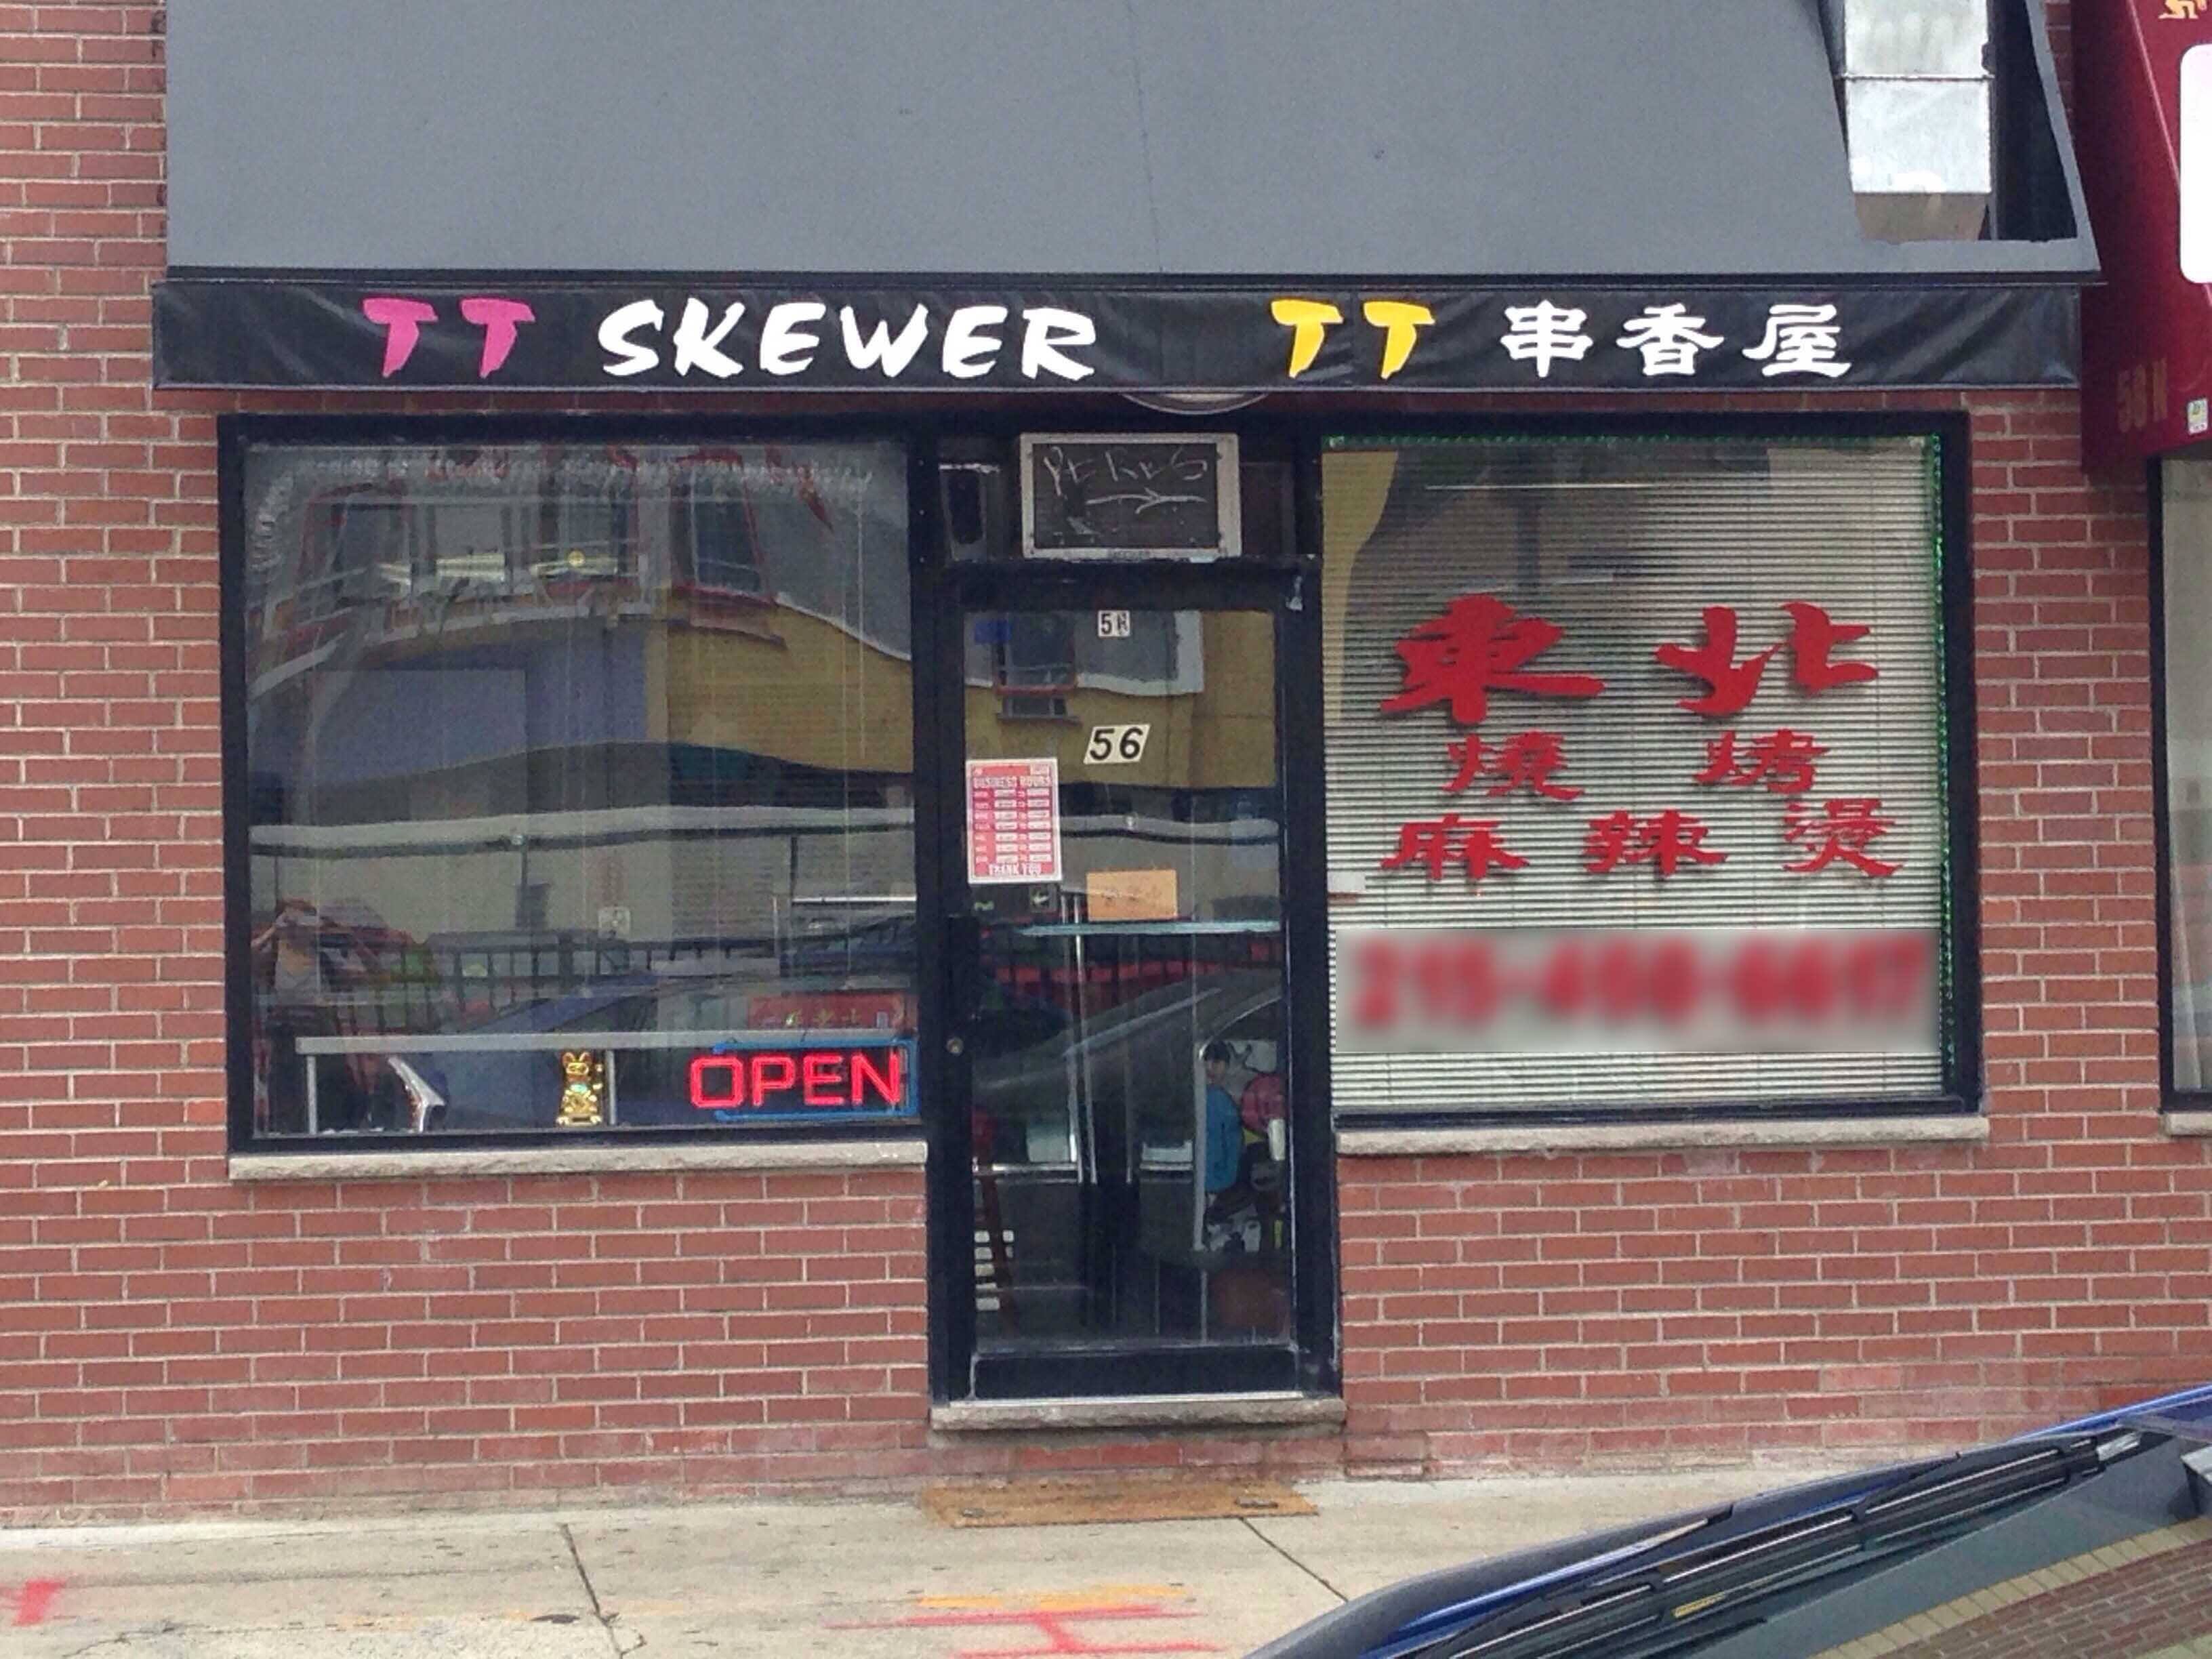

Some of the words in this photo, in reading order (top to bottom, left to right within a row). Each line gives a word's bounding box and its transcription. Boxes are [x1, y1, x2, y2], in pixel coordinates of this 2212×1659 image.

[363, 297, 535, 377] TT
[597, 298, 1096, 381] SKEWER
[1271, 298, 1435, 380] TT
[1499, 300, 1851, 378] 串香屋
[1089, 727, 1143, 761] 56
[689, 1052, 901, 1109] OPEN
